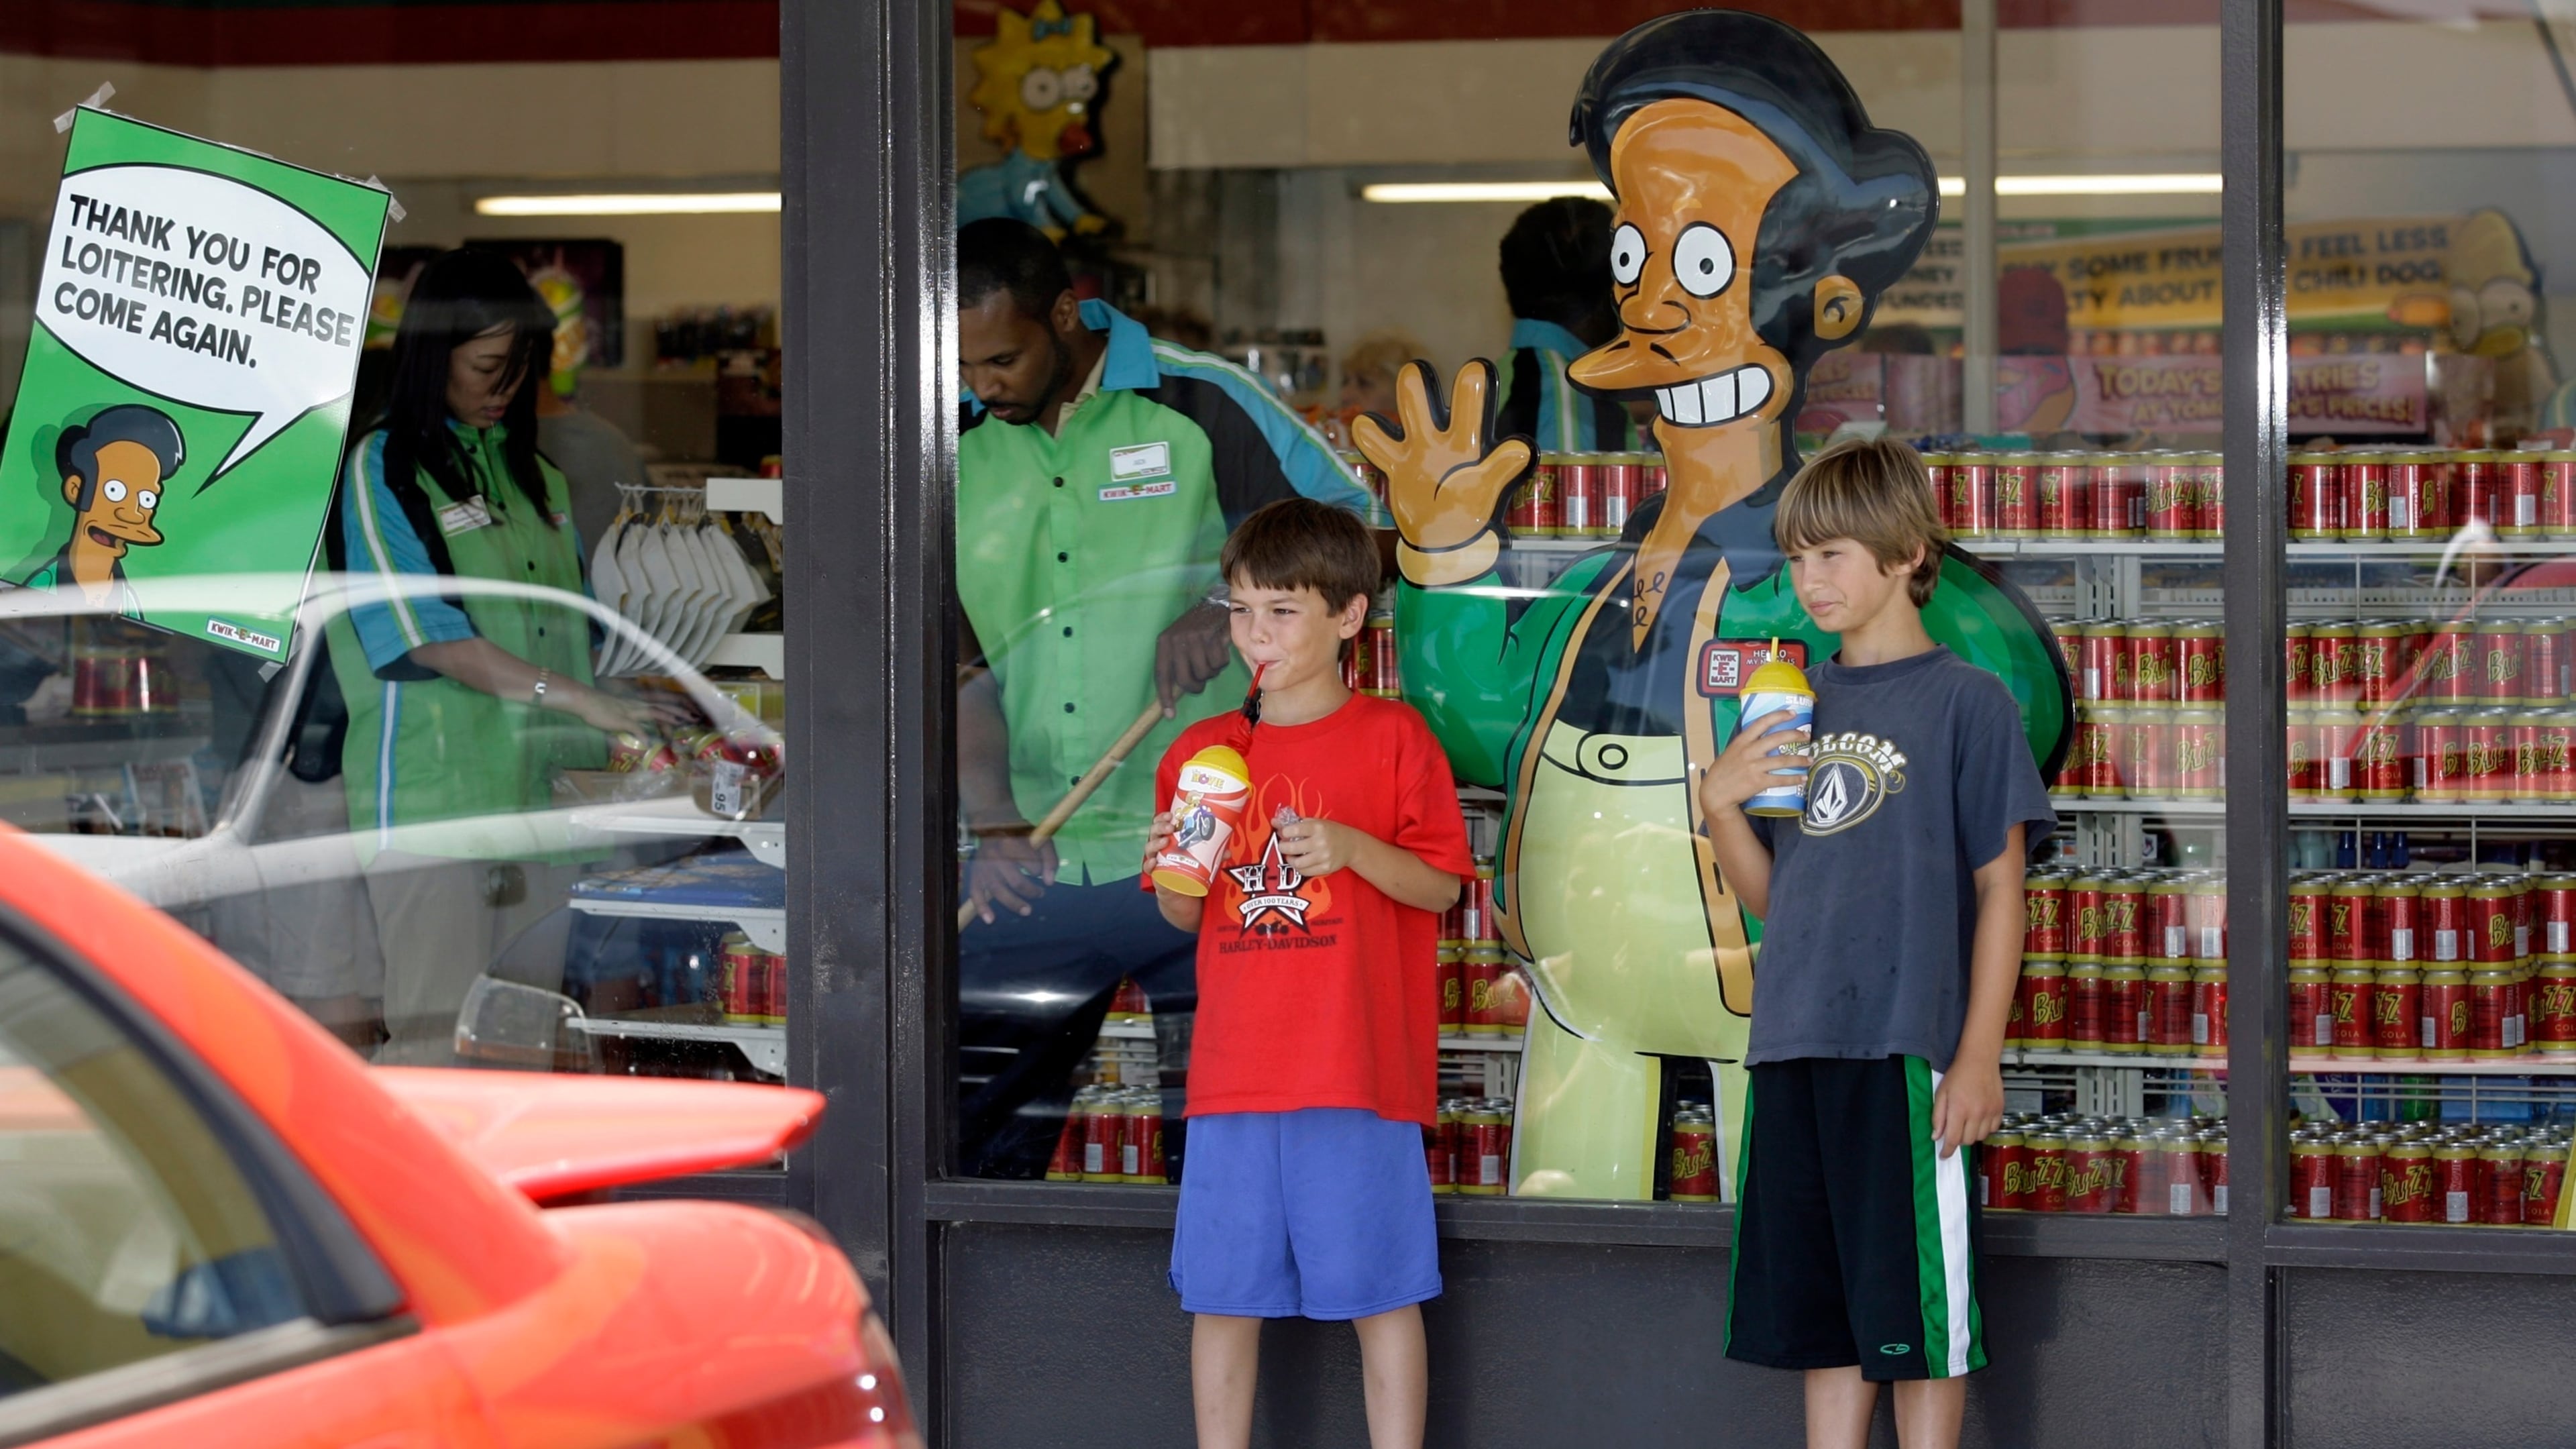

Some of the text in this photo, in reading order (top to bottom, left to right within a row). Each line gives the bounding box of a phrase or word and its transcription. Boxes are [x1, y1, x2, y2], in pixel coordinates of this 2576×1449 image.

[69, 194, 321, 295] THANK YOU FOR
[2302, 224, 2446, 258] FEEL LESS
[2068, 251, 2148, 280] SOME
[2294, 259, 2439, 292] CHILI DOG
[62, 235, 356, 347] LOITERING. PLEASE
[2119, 278, 2215, 308] ABOUT
[54, 282, 257, 368] COME AGAIN.
[2096, 364, 2222, 399] TODAY'S
[1713, 654, 1736, 662] KWIK
[1753, 649, 1786, 658] HEO
[1810, 731, 1908, 774] LCOM
[1242, 864, 1303, 893] H-D
